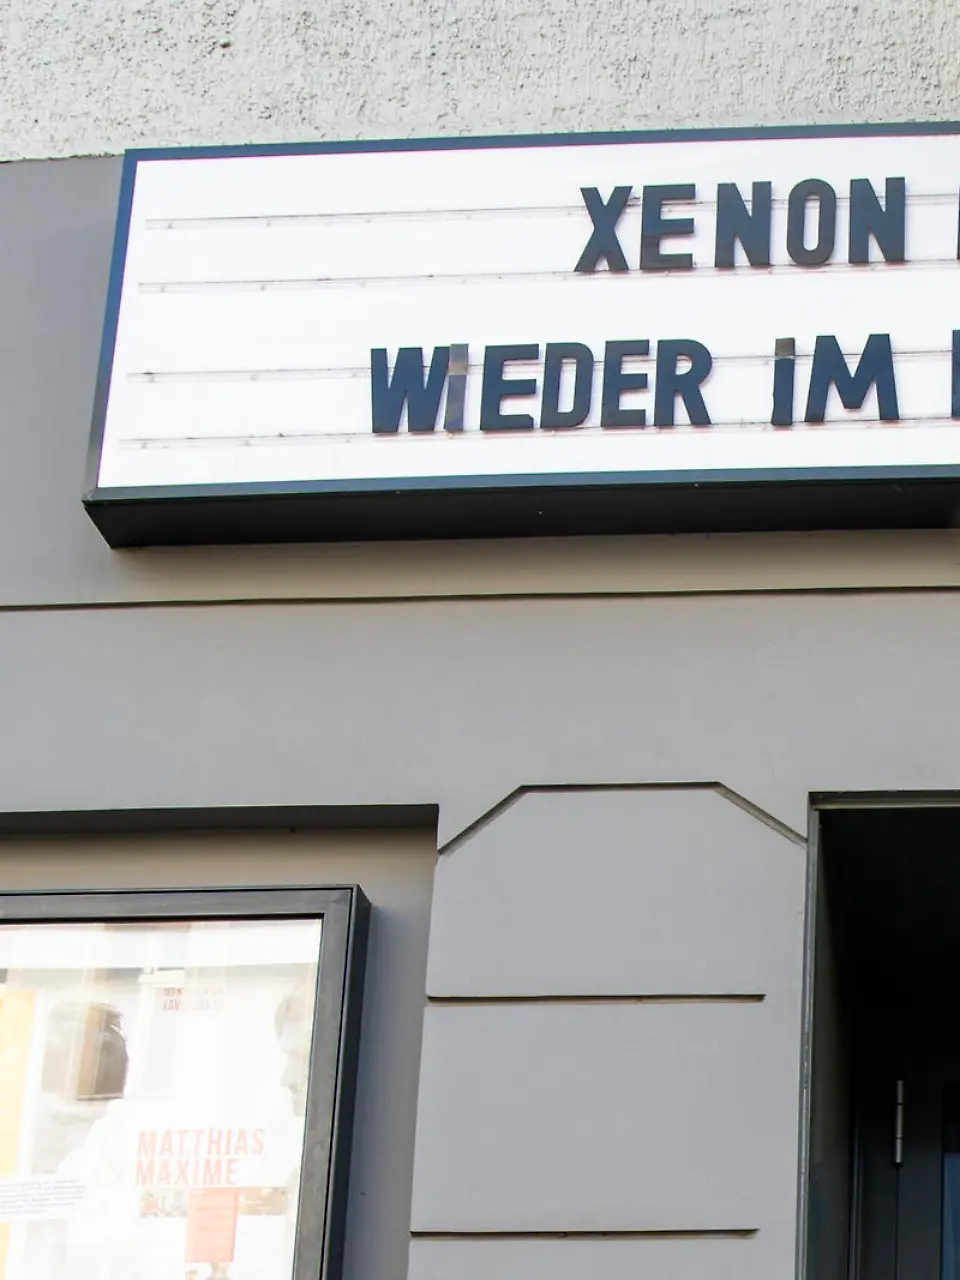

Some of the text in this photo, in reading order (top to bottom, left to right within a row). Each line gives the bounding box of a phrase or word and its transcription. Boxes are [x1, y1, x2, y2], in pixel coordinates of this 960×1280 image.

[574, 176, 906, 272] XENON
[370, 339, 713, 433] WIEDER
[135, 1158, 240, 1186] MAXIME
[138, 1128, 266, 1156] MATTHIAS
